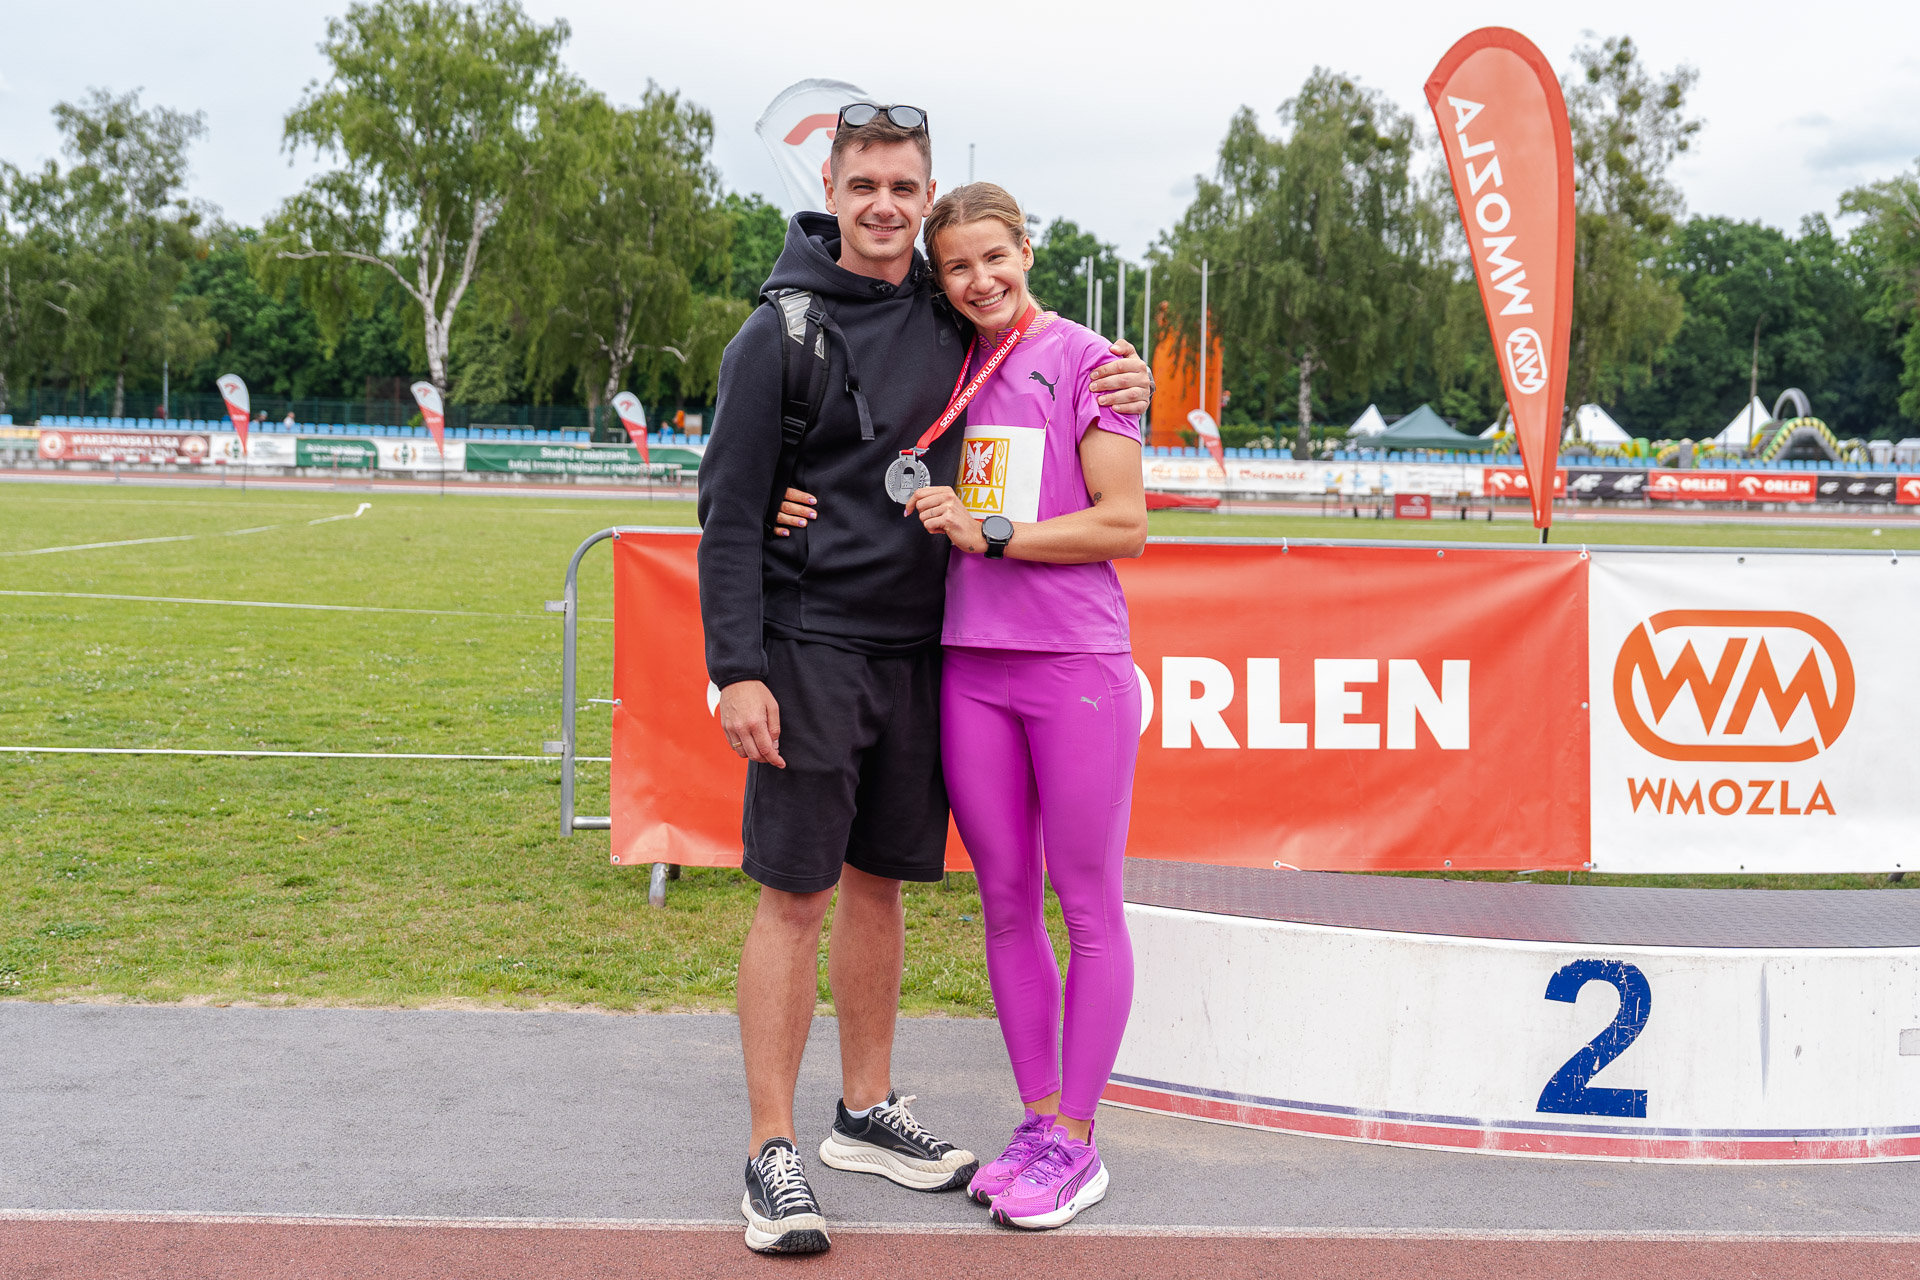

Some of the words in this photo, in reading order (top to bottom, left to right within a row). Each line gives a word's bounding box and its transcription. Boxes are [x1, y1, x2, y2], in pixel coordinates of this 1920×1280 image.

[975, 329, 1021, 384] MISTRZOSTWA
[954, 384, 979, 412] POLSKI
[939, 408, 957, 428] 2025
[153, 435, 180, 448] LIGA
[1680, 478, 1728, 492] ORLEN
[1763, 479, 1811, 494] ORLEN
[1134, 656, 1470, 750] RLEN
[1626, 776, 1837, 816] WMOZLA
[1535, 958, 1652, 1119] 2
